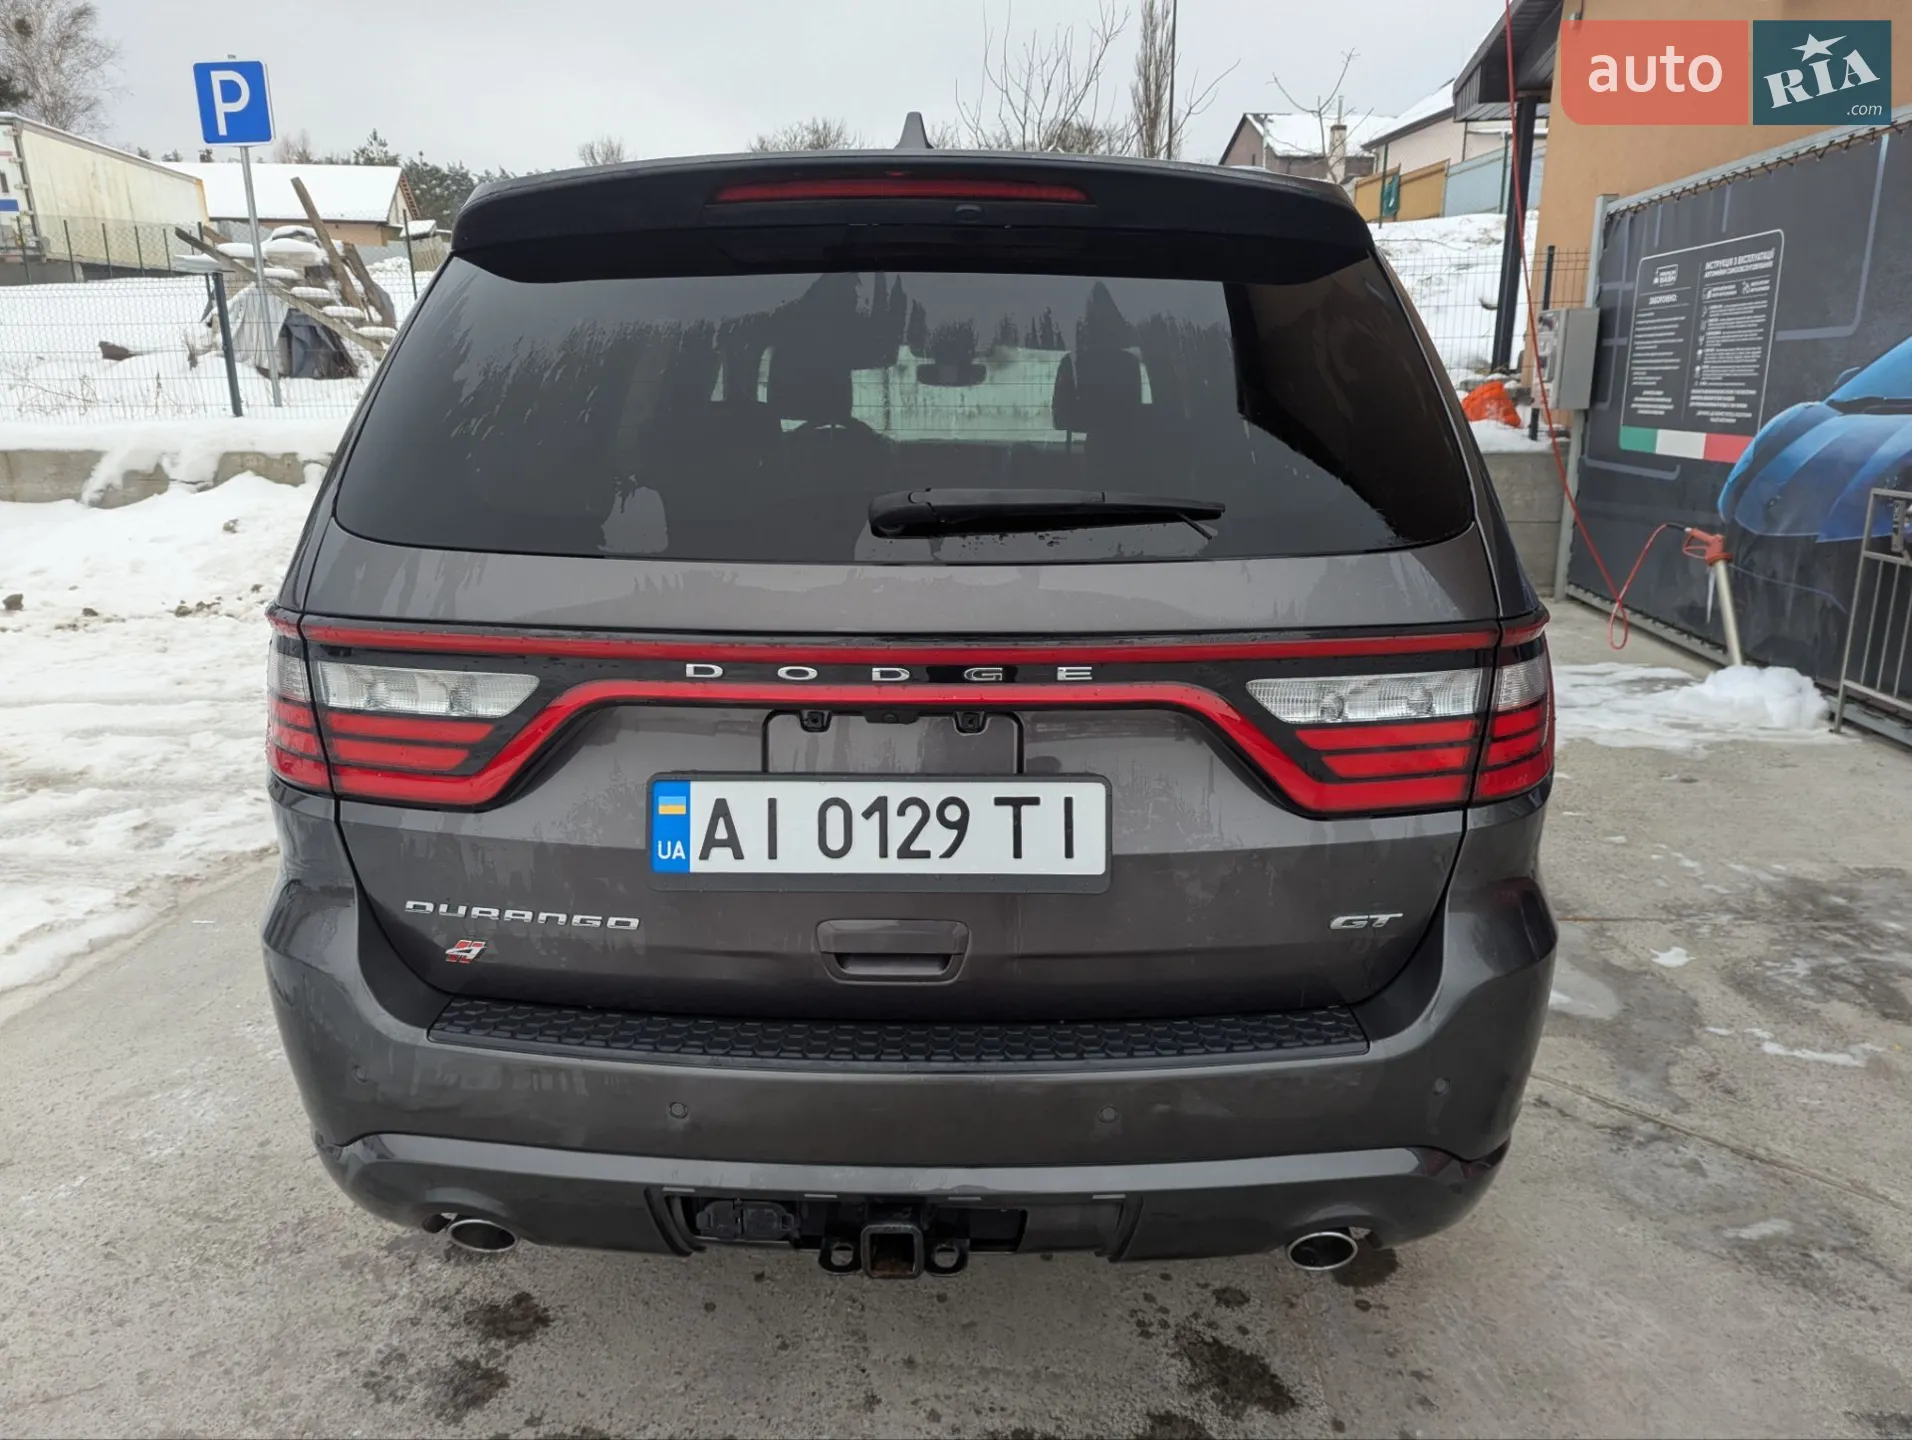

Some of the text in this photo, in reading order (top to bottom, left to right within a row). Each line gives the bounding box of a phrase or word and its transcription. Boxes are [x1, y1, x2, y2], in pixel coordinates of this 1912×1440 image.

[210, 70, 250, 136] P
[685, 663, 1093, 681] DODGE
[698, 796, 1075, 860] AI 0129 TI
[657, 840, 686, 860] UA
[404, 900, 640, 930] DURANGO
[1330, 913, 1403, 929] GT
